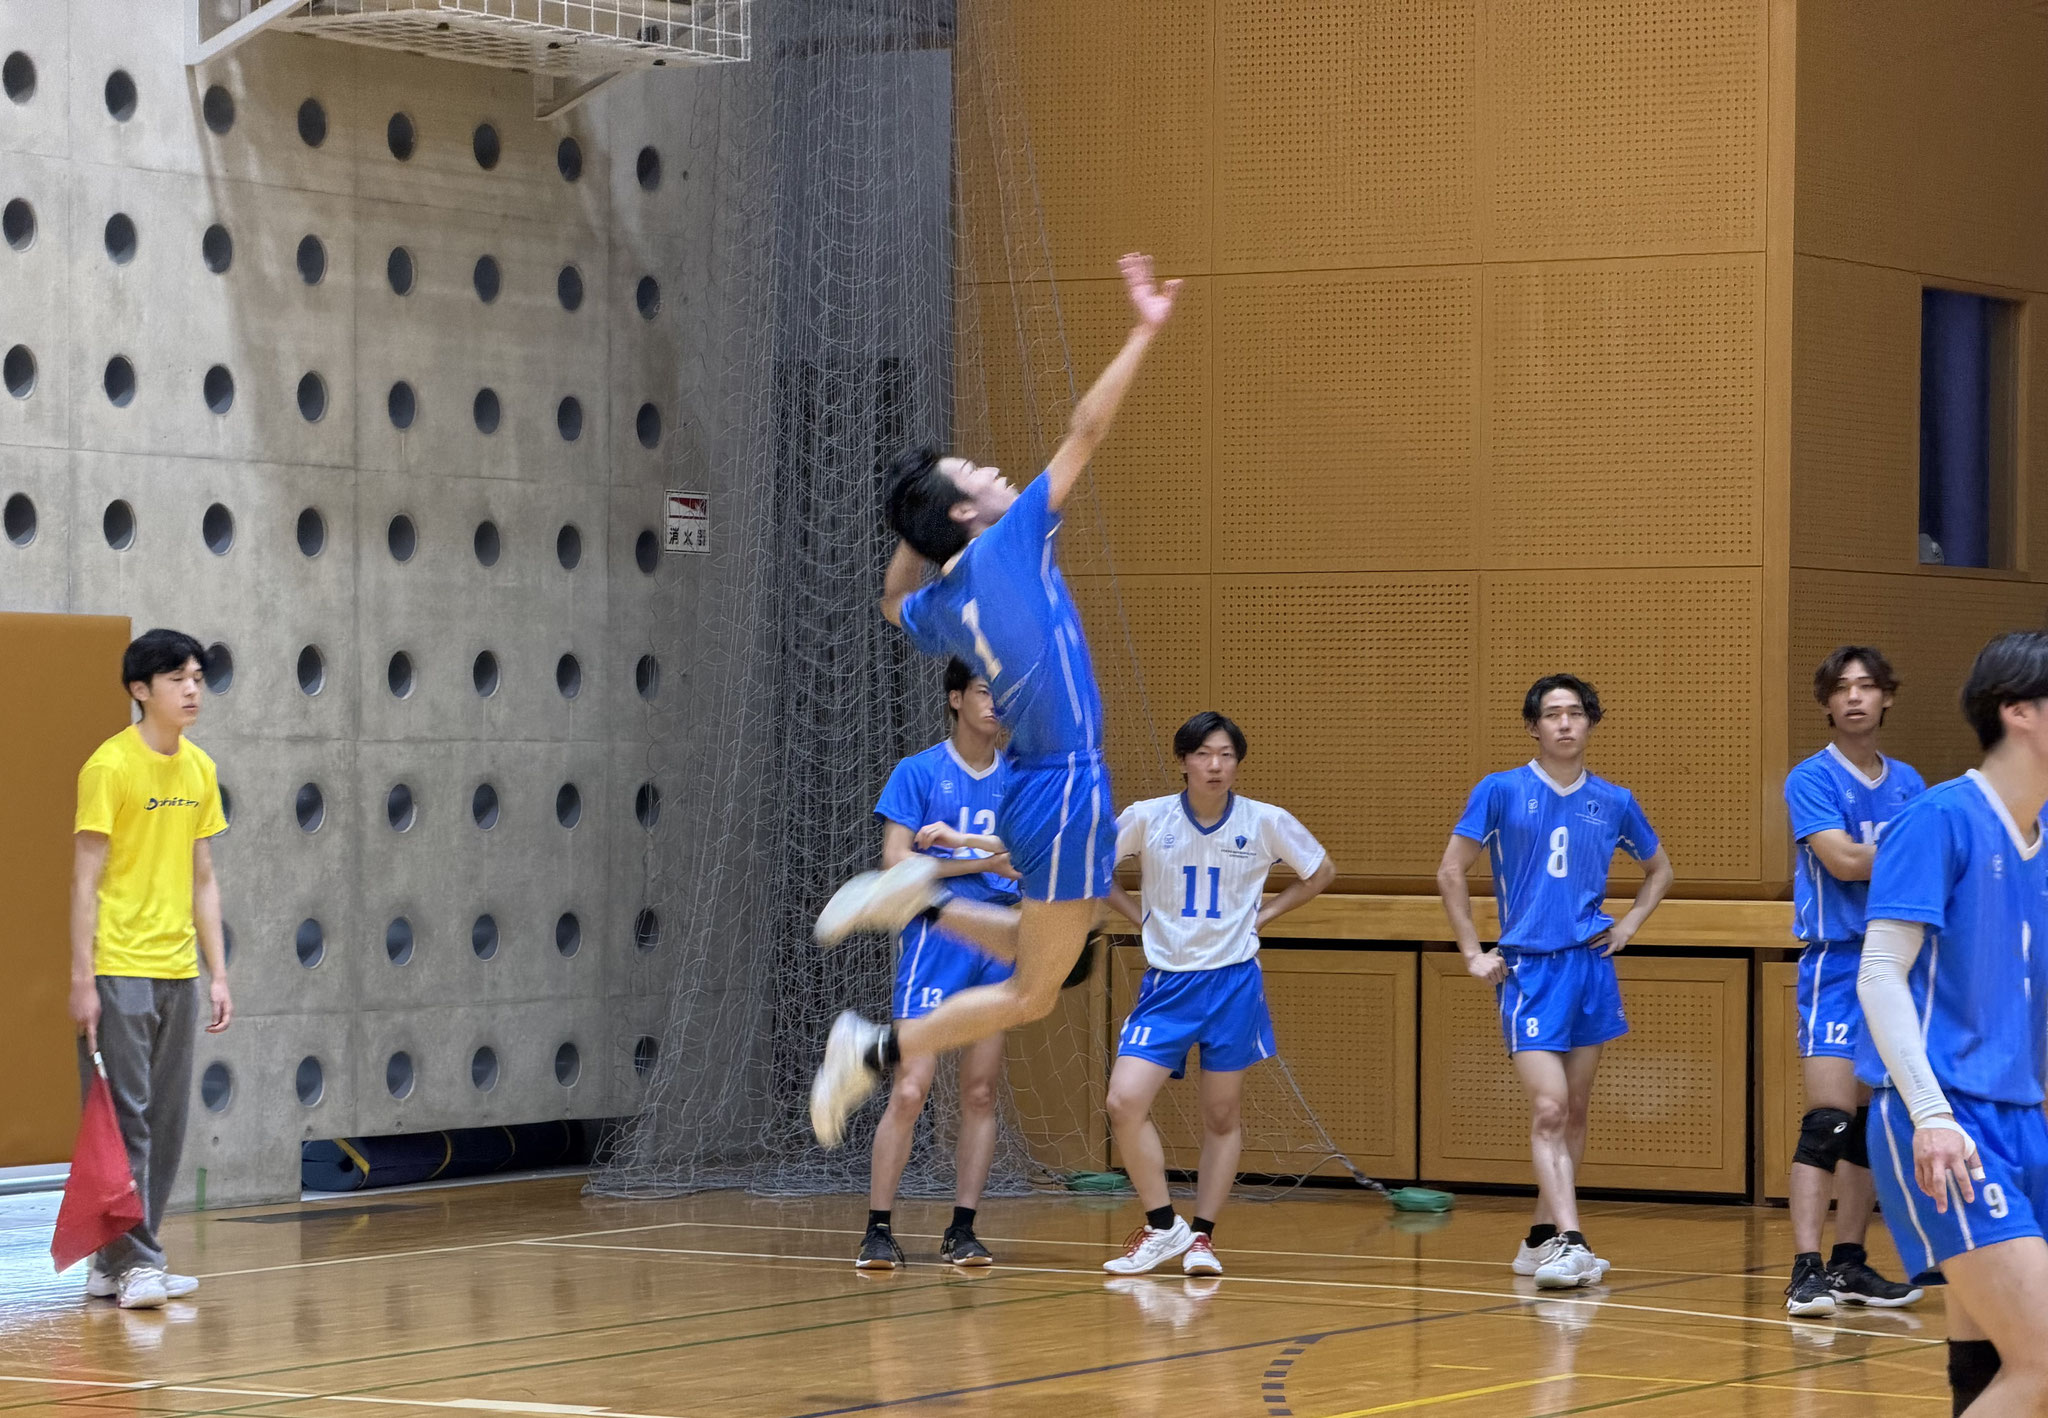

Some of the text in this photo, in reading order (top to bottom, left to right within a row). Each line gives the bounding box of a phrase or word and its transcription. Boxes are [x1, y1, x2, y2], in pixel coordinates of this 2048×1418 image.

[1546, 826, 1570, 879] 8
[1181, 865, 1222, 919] 11
[920, 986, 943, 1009] 13
[1128, 1025, 1153, 1046] 11
[1526, 1017, 1540, 1038] 8
[1823, 1021, 1849, 1045] 12
[1983, 1182, 2009, 1219] 9
